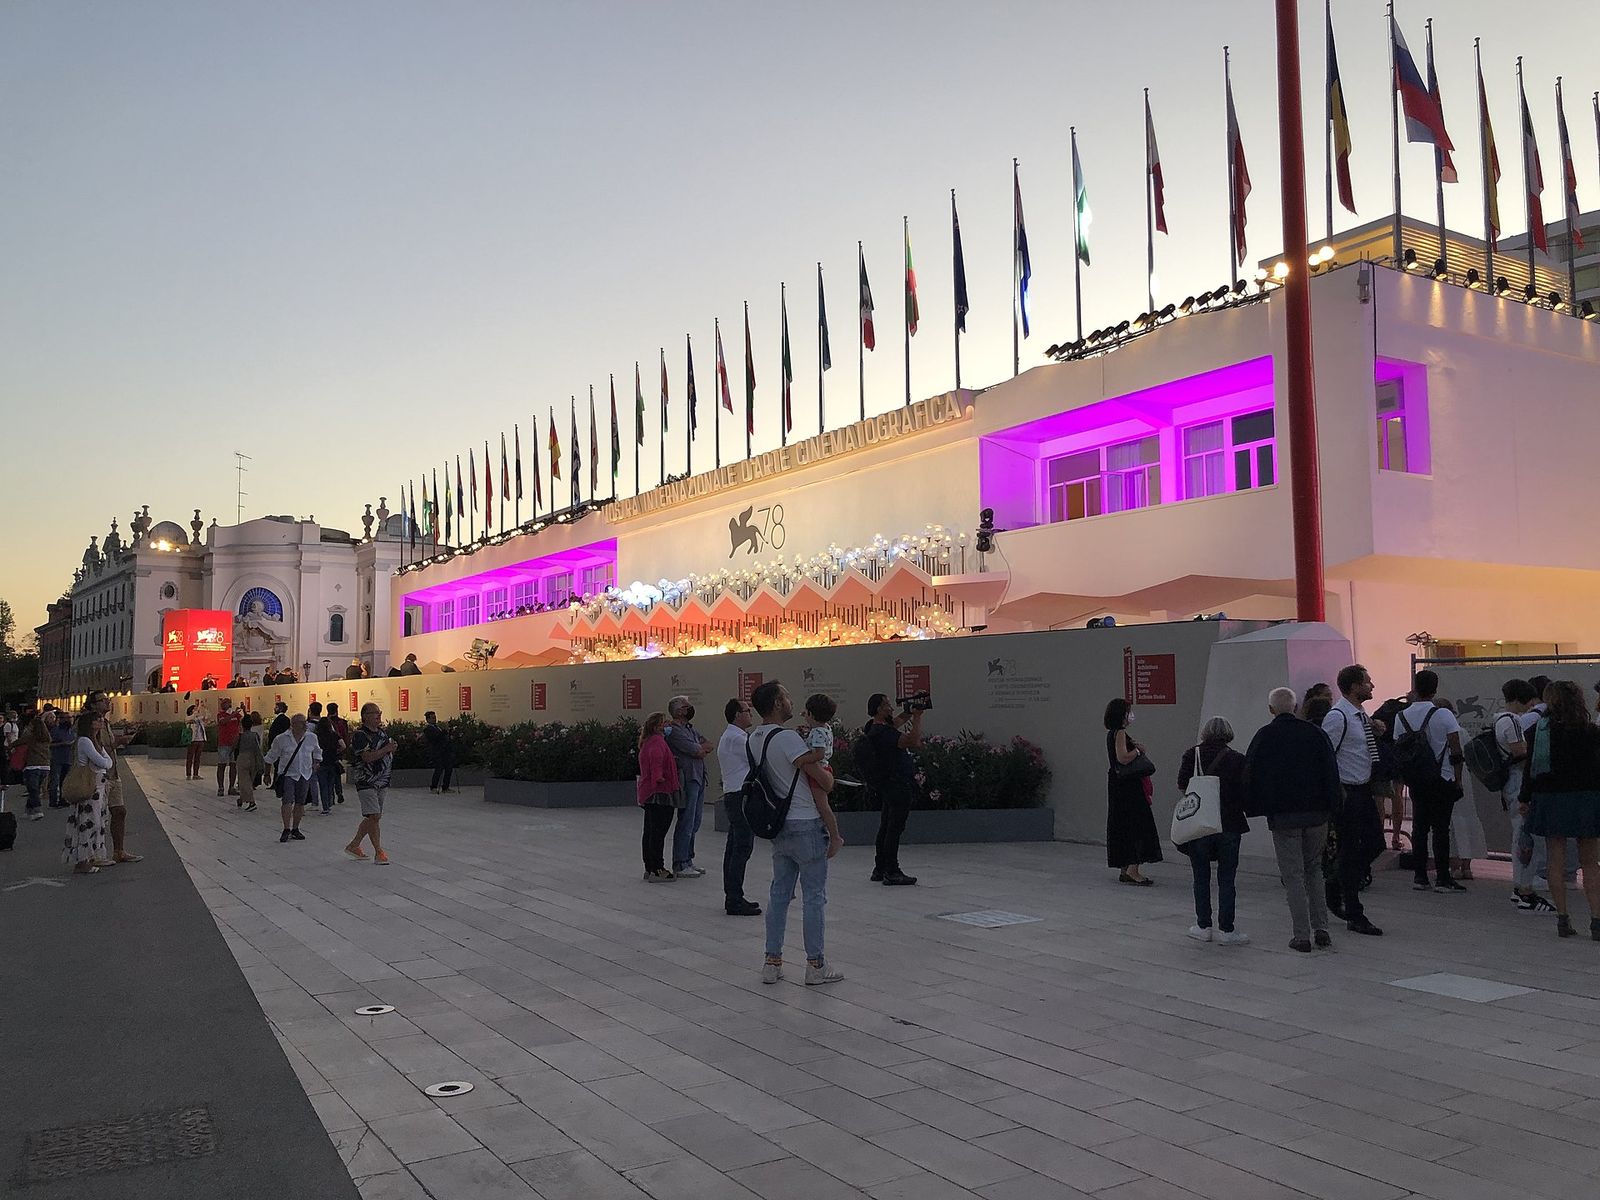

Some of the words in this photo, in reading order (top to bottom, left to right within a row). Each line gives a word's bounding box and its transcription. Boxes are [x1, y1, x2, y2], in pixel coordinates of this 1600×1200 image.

[643, 463, 738, 510] INTERNAZIONALE
[740, 448, 791, 483] D'ARTE
[795, 394, 963, 465] CINEMATOGRAFICA
[757, 504, 786, 552] 78
